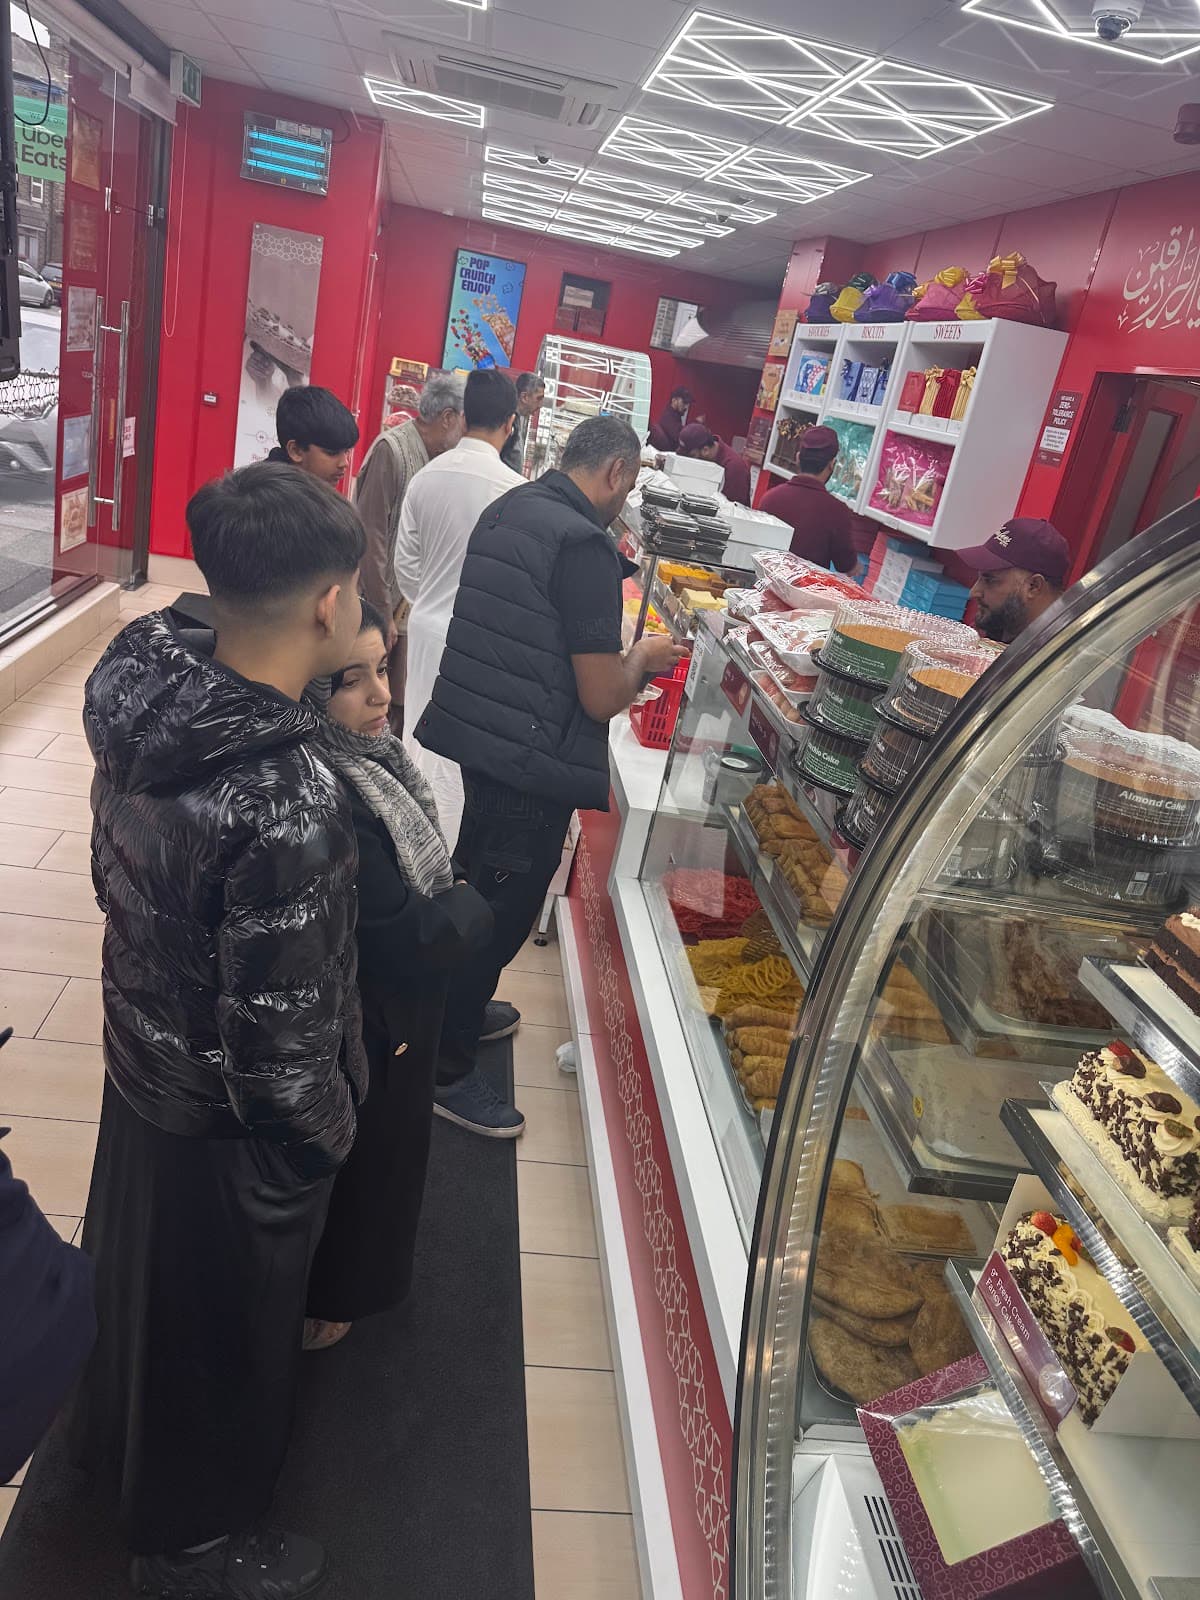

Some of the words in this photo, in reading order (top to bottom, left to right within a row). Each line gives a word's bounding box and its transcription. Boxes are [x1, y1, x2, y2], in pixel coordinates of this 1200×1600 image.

[469, 257, 490, 270] POP
[460, 267, 496, 284] CRUNCH
[461, 279, 491, 295] ENJOY
[934, 324, 963, 340] SWEETS
[1052, 408, 1074, 418] TOLERANCE
[1053, 417, 1067, 425] POLICY
[1119, 790, 1164, 807] Almond
[1164, 800, 1186, 811] Cake
[985, 1277, 1002, 1308] Fancy
[1000, 1304, 1016, 1332] Cake
[996, 1278, 1013, 1308] Fresh
[1011, 1305, 1031, 1341] Cream
